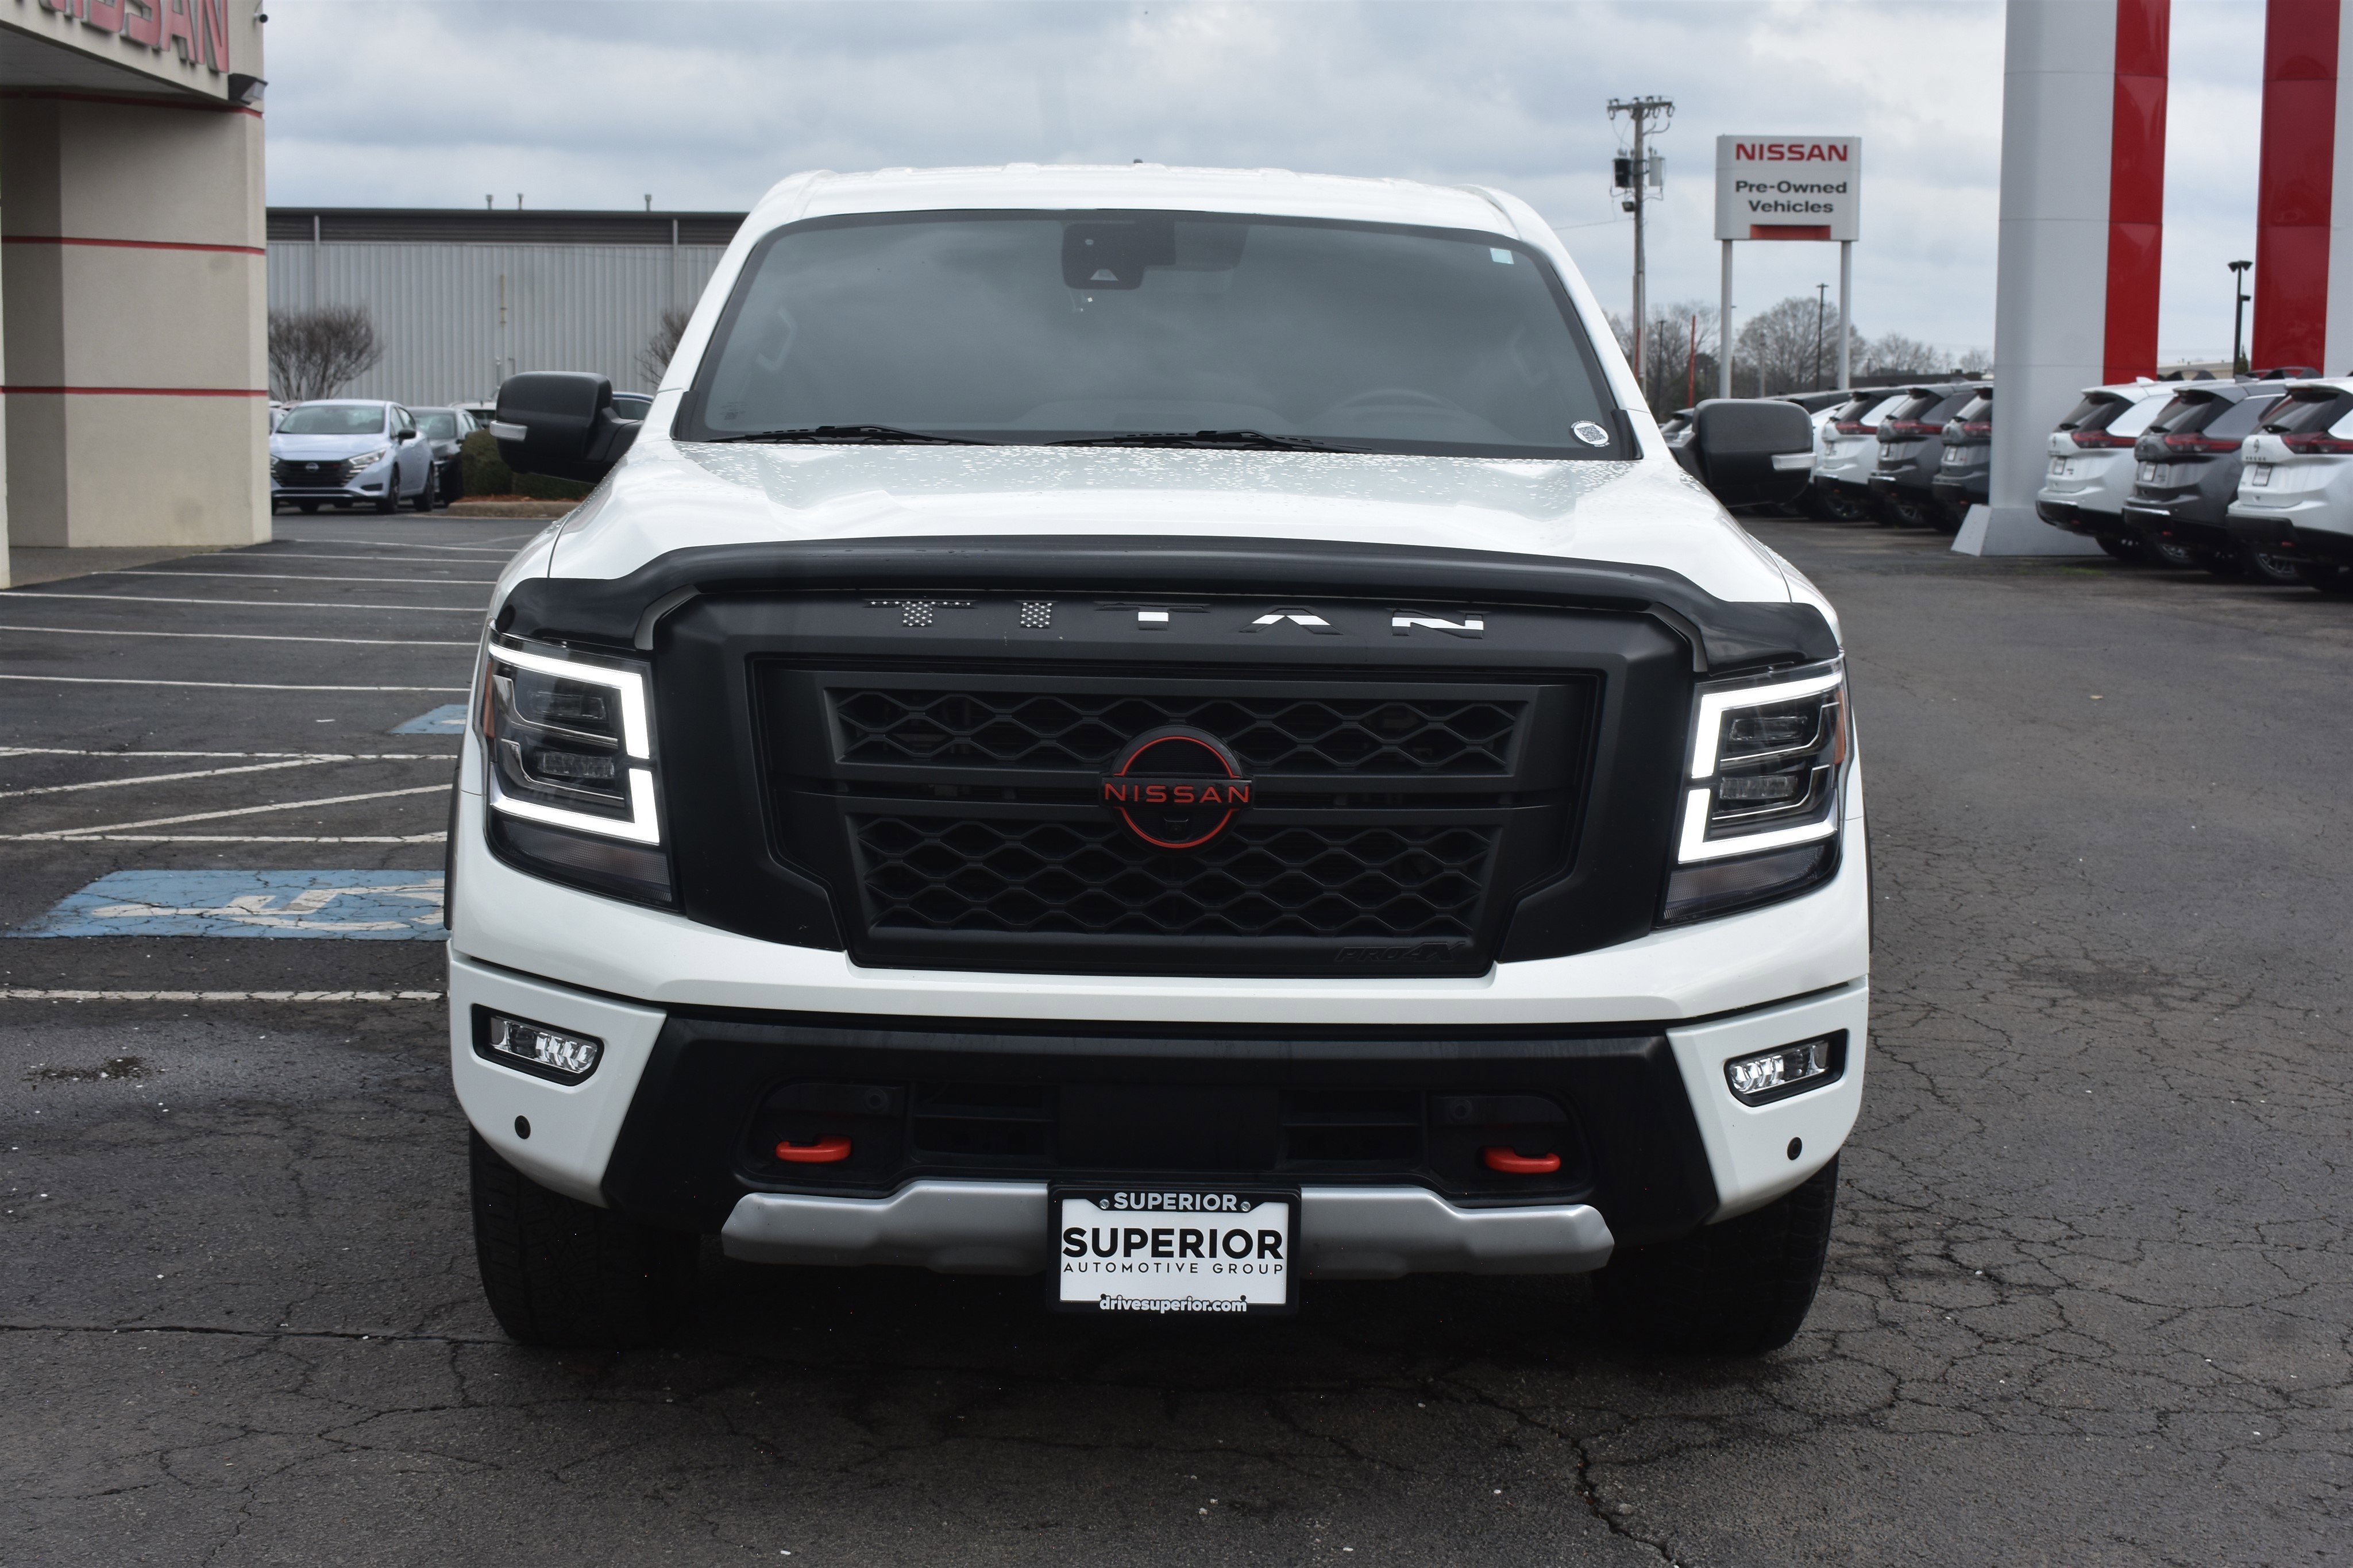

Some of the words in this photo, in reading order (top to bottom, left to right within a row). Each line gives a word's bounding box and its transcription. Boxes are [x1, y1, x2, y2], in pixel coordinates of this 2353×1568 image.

[1735, 143, 1847, 161] NISSAN
[1735, 180, 1847, 194] Pre-Owned
[1749, 200, 1834, 213] Vehicles
[863, 600, 1484, 639] TITAN
[1105, 783, 1249, 804] NISSAN
[1113, 1192, 1237, 1211] SUPERIOR
[1062, 1227, 1284, 1260] SUPERIOR
[1063, 1262, 1199, 1274] AUTOMOTIVE
[1212, 1262, 1283, 1275] GROUP
[1100, 1295, 1248, 1314] drivesuperior.com
